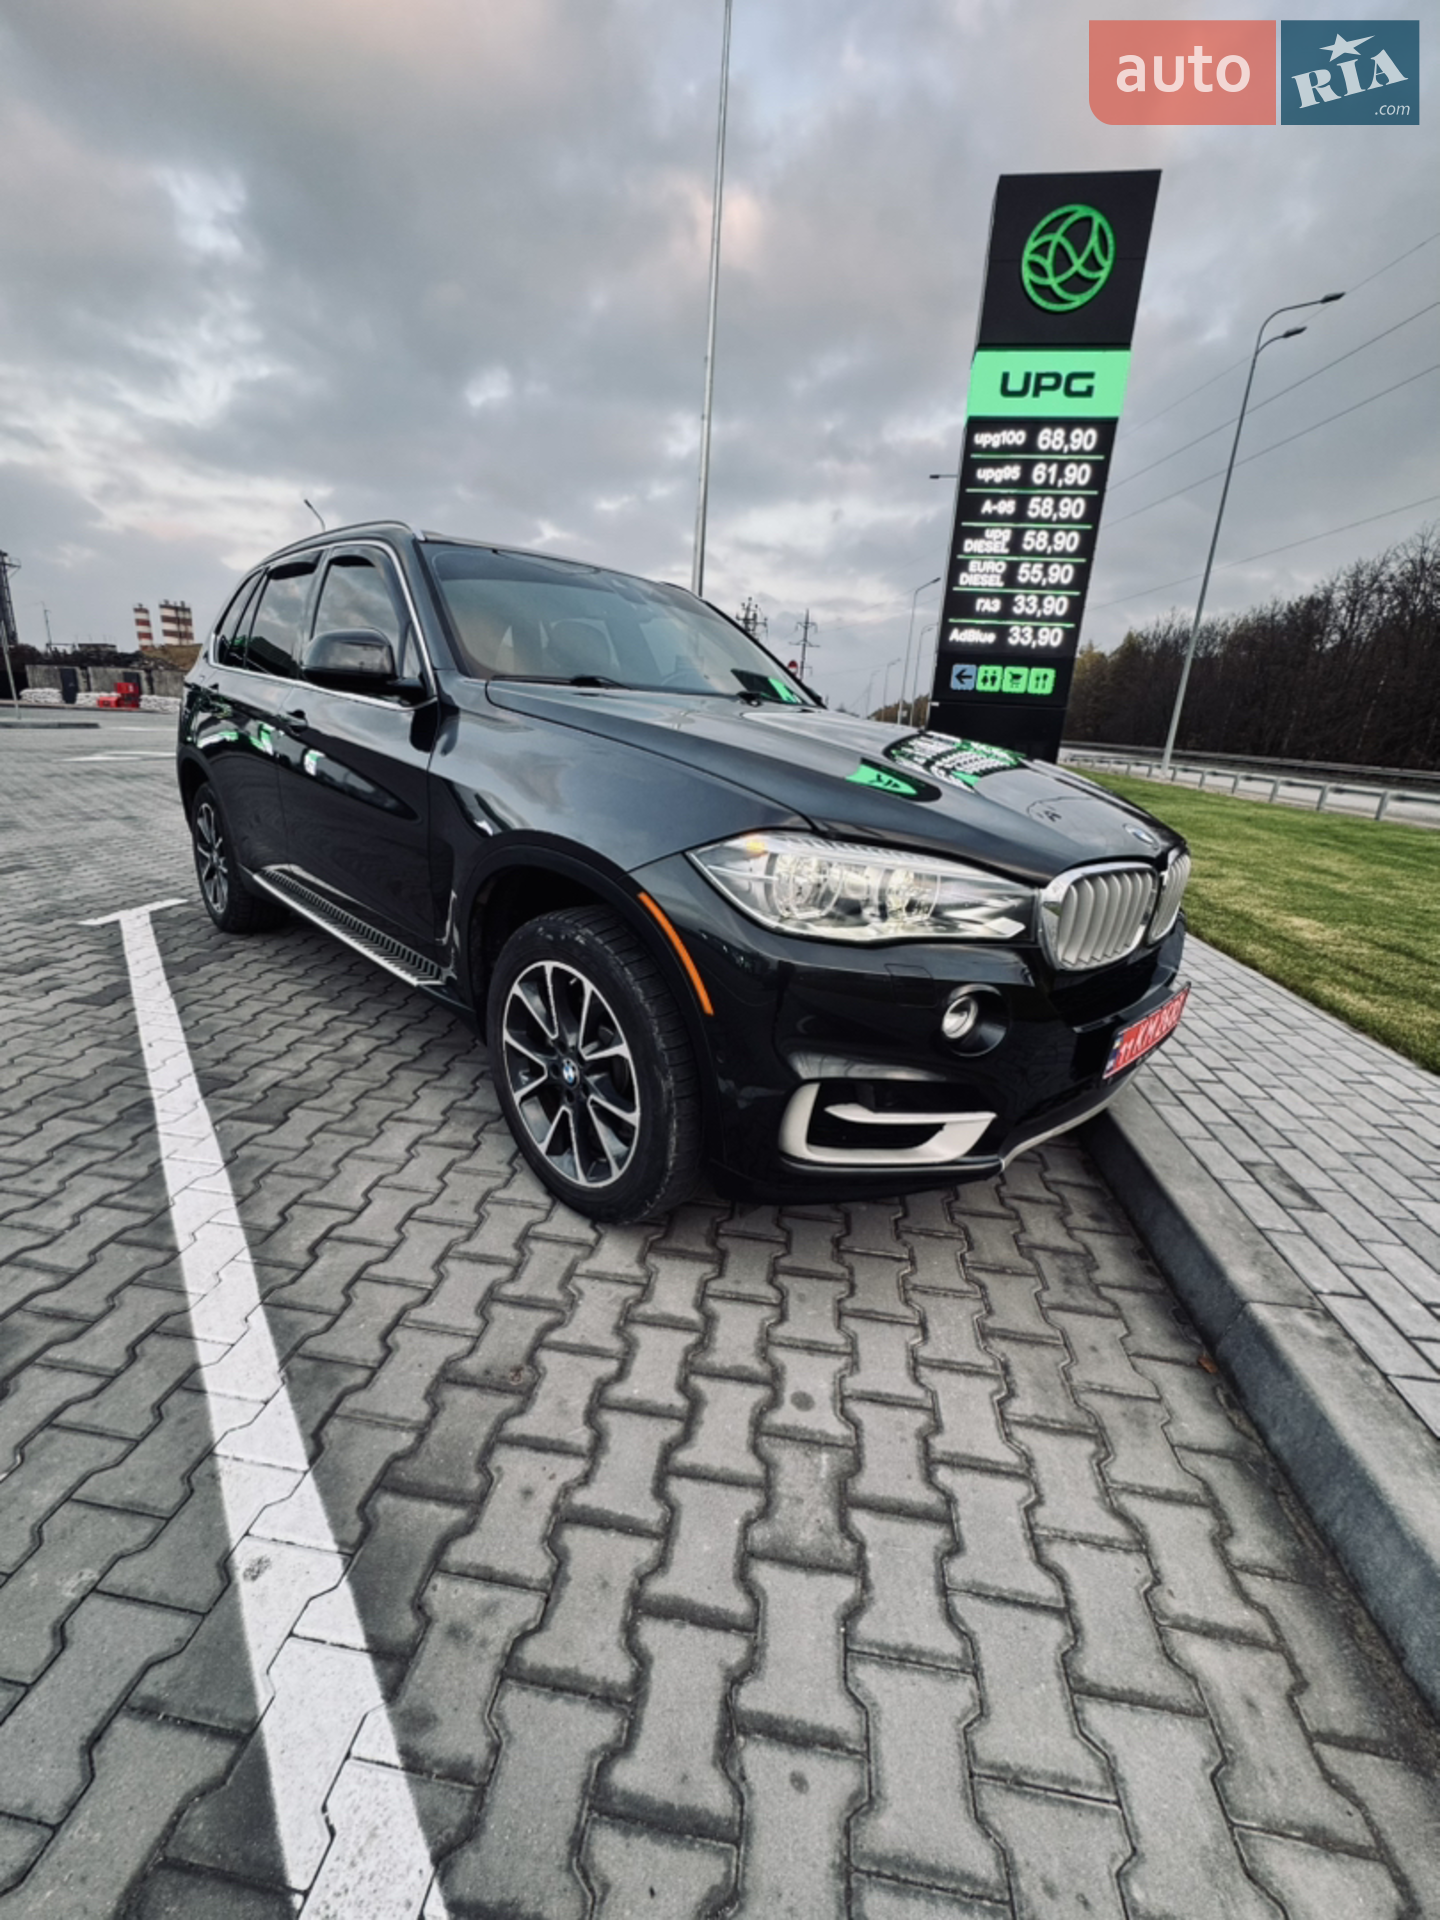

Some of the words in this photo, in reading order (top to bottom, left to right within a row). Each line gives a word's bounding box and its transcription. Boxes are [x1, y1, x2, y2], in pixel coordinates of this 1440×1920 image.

[999, 371, 1096, 398] UPG
[974, 429, 1026, 448] upg100
[1037, 427, 1097, 453] 68,90
[976, 464, 1021, 483] upg95
[1032, 462, 1091, 488] 61,90
[1027, 496, 1085, 522] 58,90
[963, 538, 1010, 554] DIESEL
[1022, 530, 1080, 554] 58,90
[968, 560, 1007, 573] EURO
[1017, 562, 1074, 586] 55,90
[959, 572, 1004, 587] DIESEL
[1012, 594, 1069, 618] 33,90
[949, 628, 996, 643] AdBlue
[1007, 625, 1063, 649] 33,90
